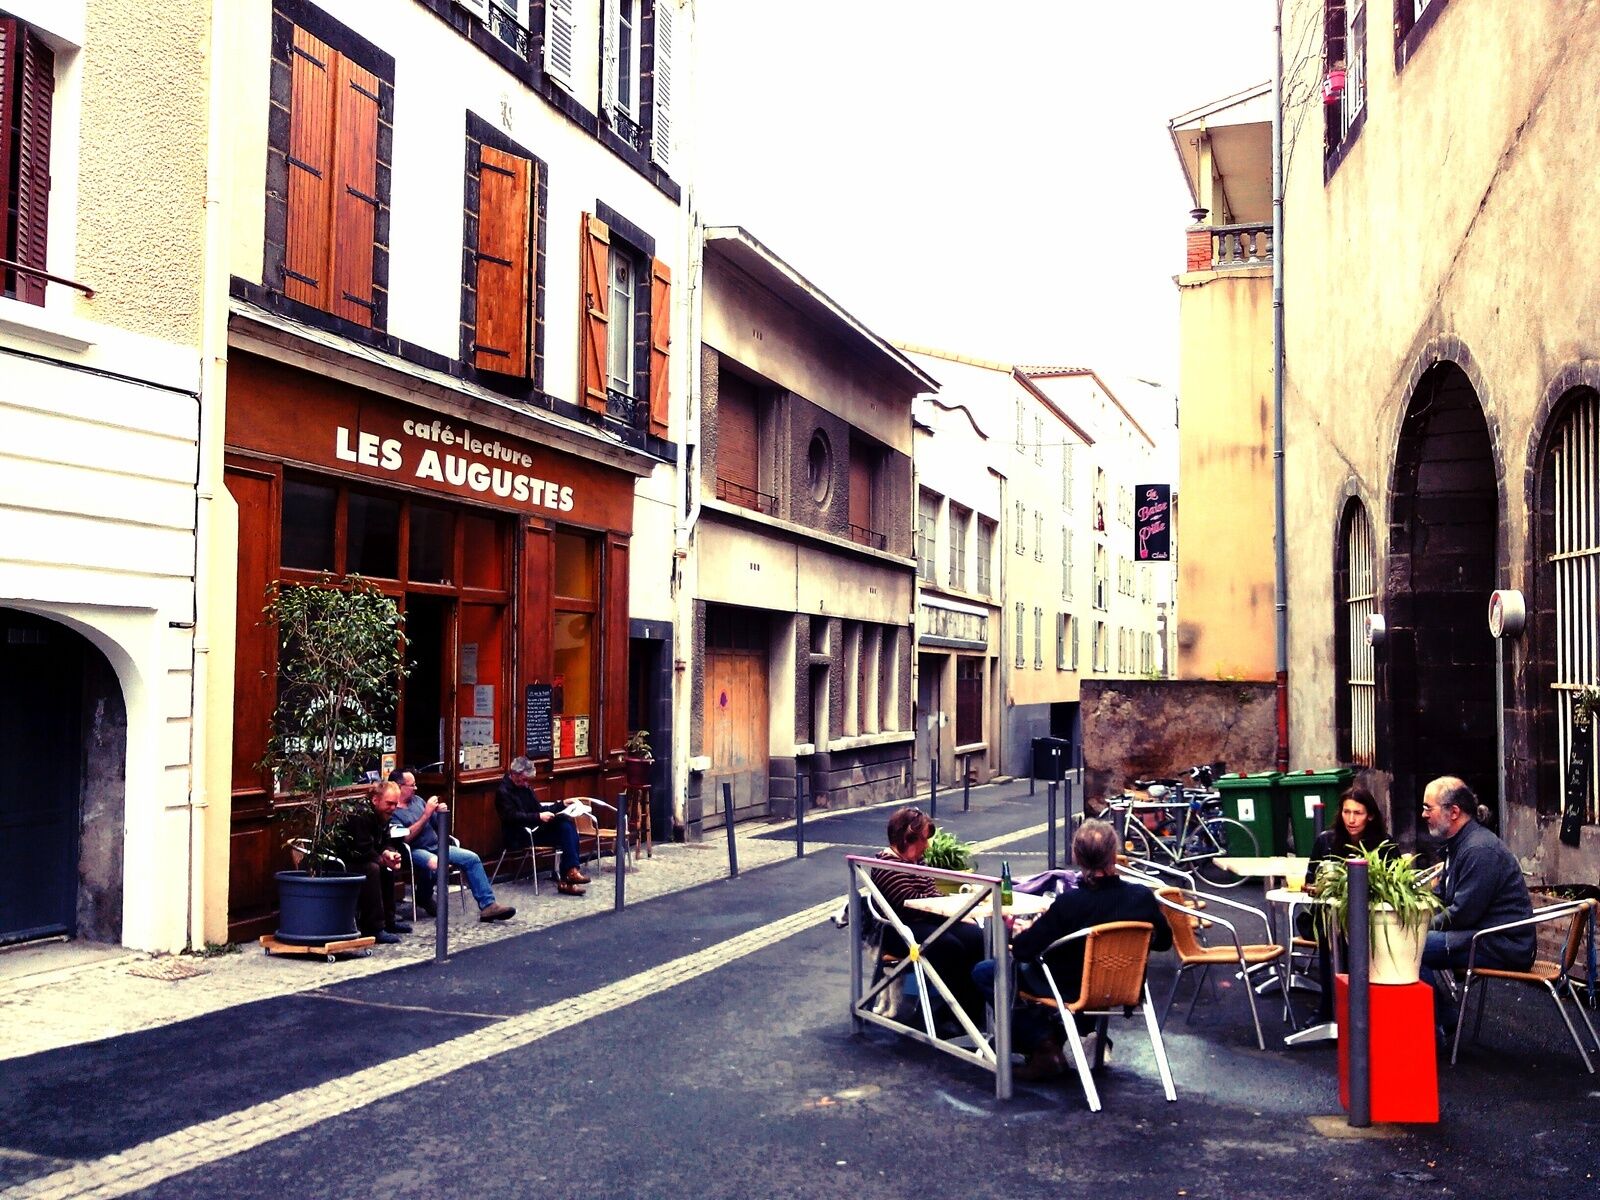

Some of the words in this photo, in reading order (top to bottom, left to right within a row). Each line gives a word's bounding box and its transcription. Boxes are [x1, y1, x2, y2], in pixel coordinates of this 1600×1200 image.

[336, 426, 403, 471] LES
[415, 449, 574, 512] AUGUSTES
[403, 419, 533, 468] café-lecture
